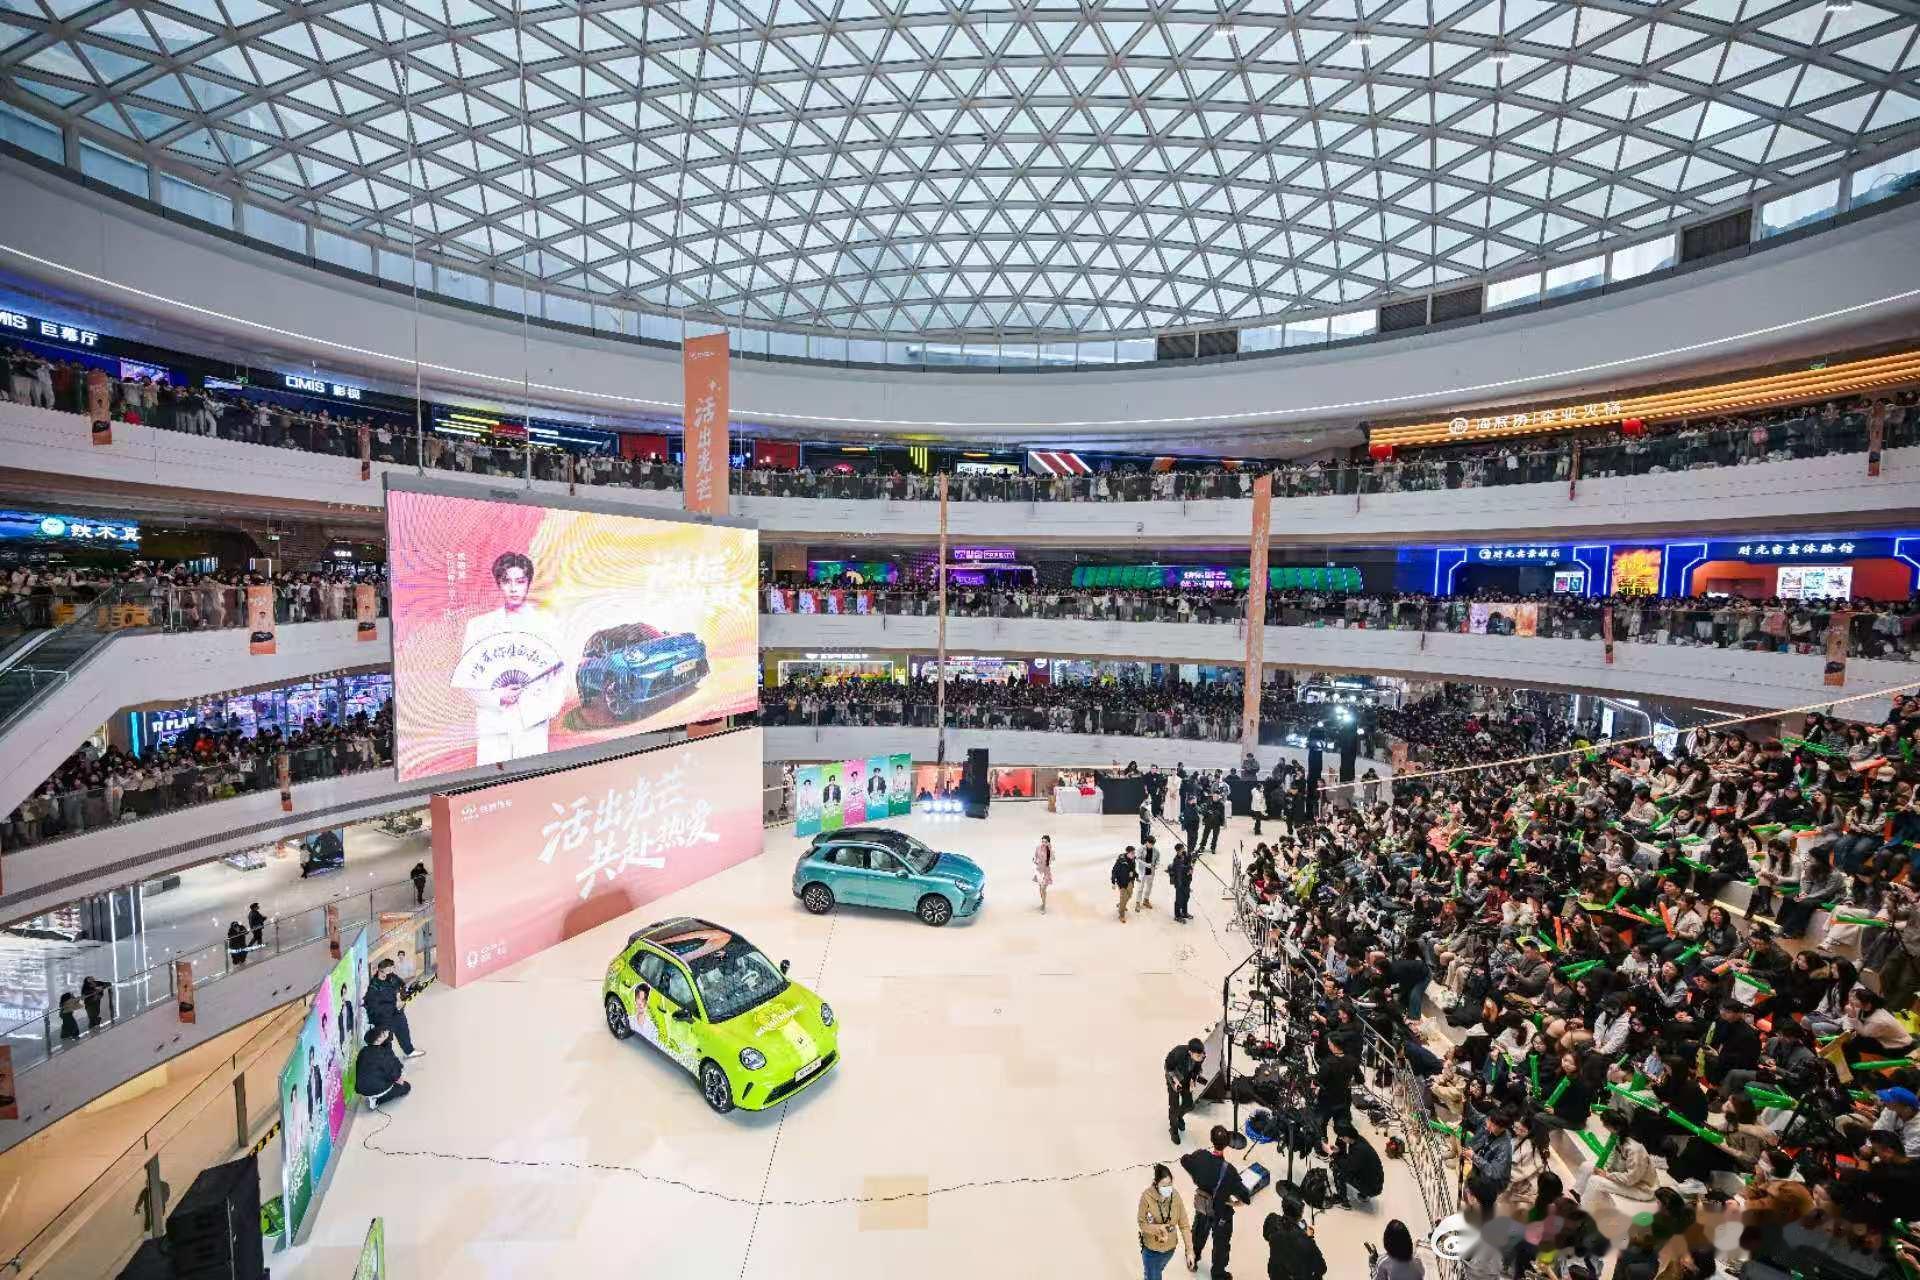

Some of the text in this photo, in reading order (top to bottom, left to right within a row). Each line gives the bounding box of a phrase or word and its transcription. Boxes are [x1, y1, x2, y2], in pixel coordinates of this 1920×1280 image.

[41, 320, 98, 346] 巨幕厅
[693, 396, 717, 501] 活出光芒
[1738, 541, 1856, 556] 时光密室体验馆
[537, 764, 690, 865] 活出光芒
[575, 799, 721, 900] 共赴热爱
